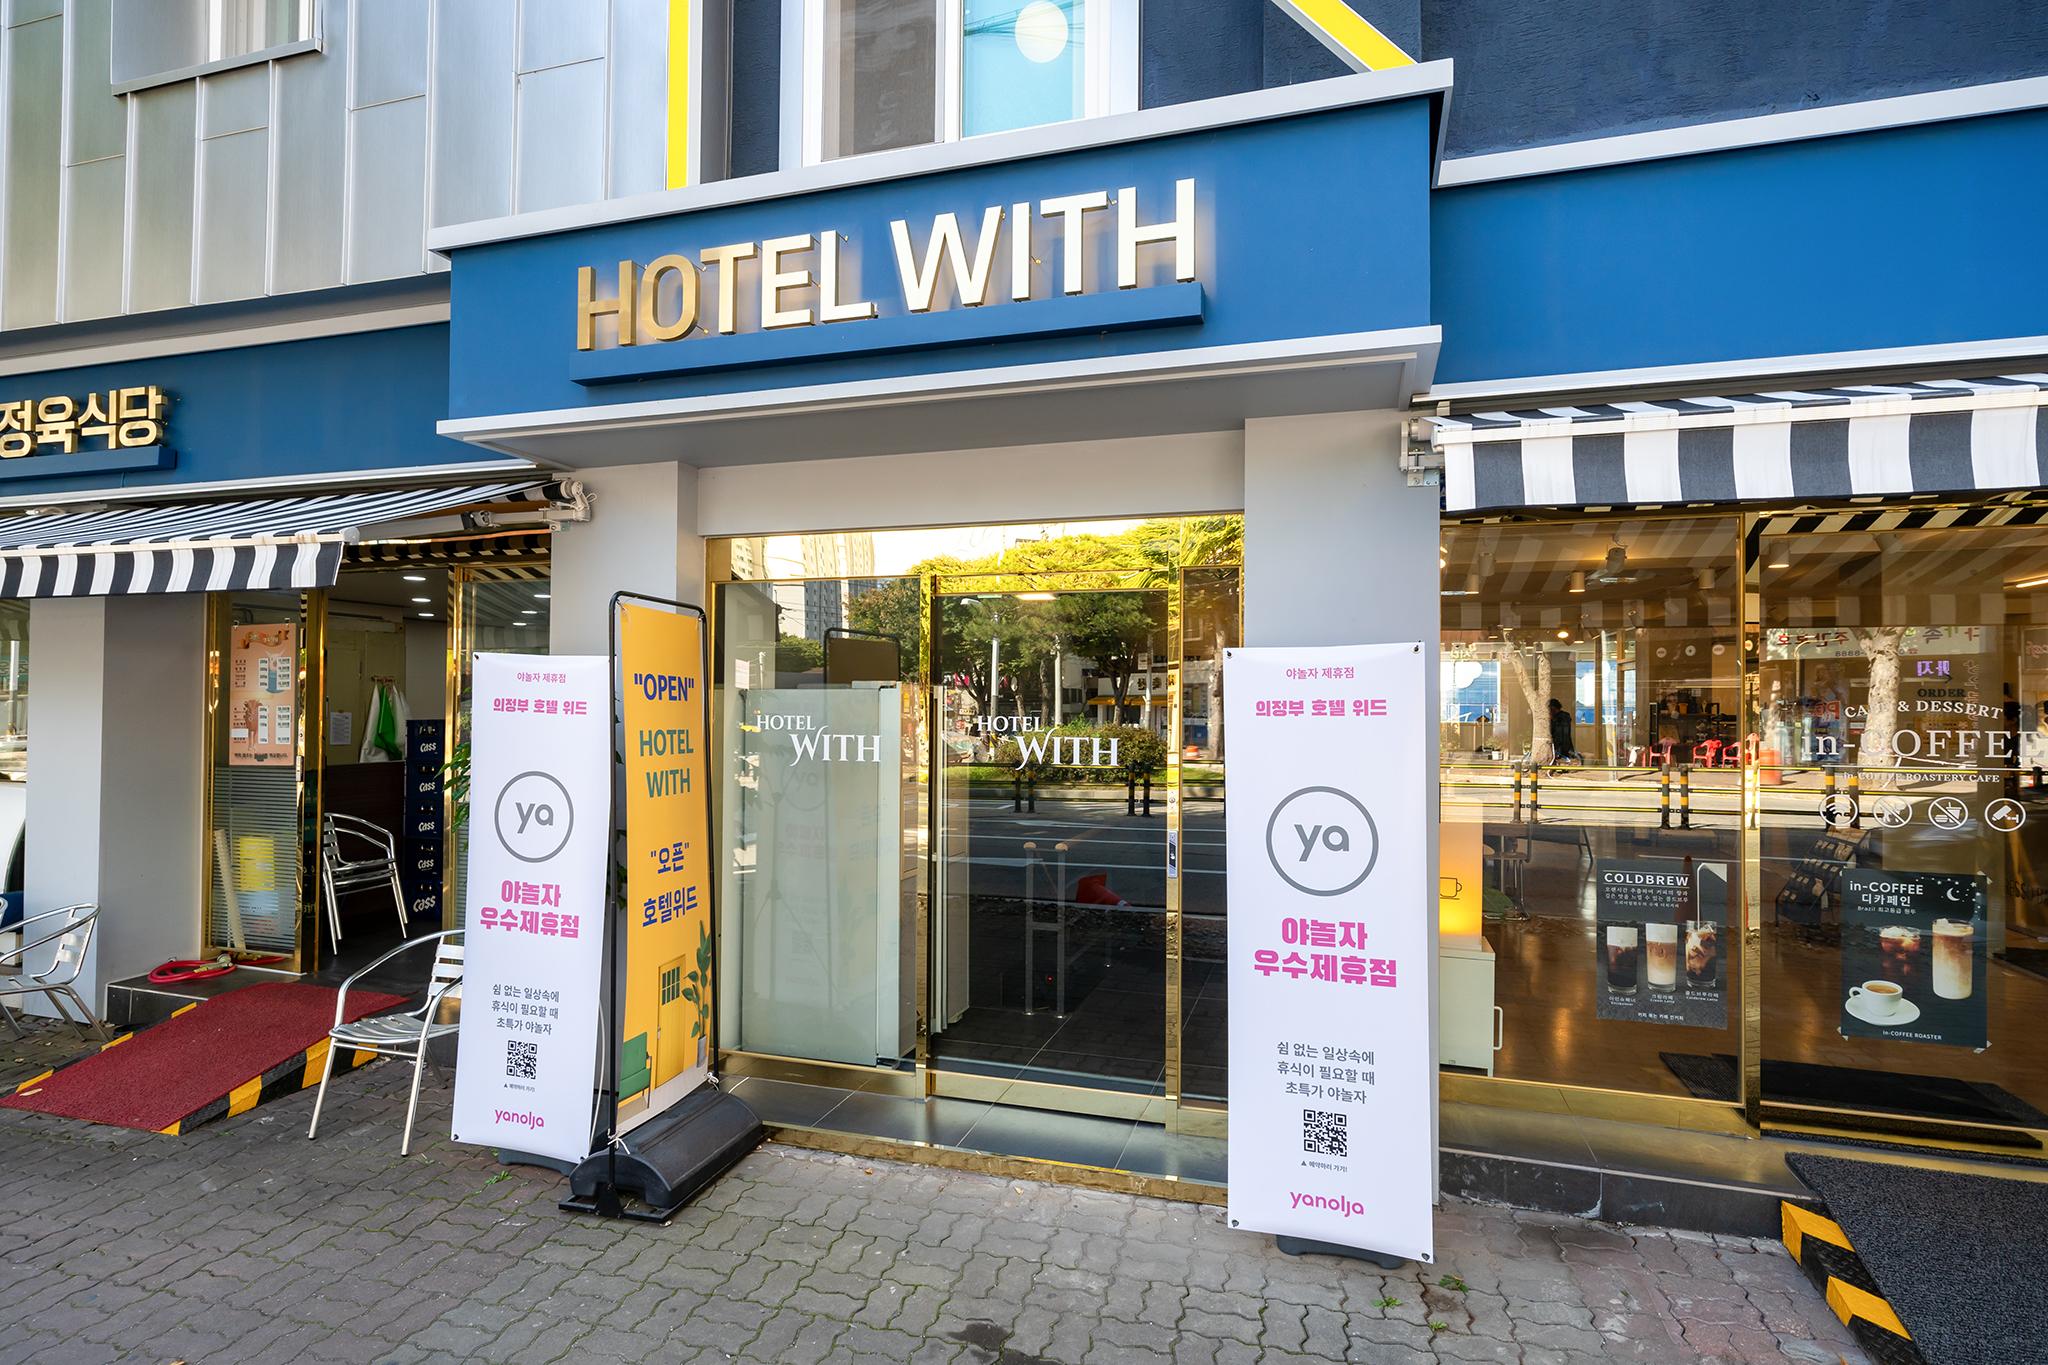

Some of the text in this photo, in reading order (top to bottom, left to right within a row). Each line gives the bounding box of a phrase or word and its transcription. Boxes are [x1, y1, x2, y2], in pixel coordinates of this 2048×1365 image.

[577, 178, 1196, 351] HOTEL WITH
[0, 385, 165, 459] 정육식당
[516, 672, 566, 684] 야놀자 제휴점
[1286, 667, 1355, 679] 야놀자 제휴점
[633, 672, 695, 701] "OPEN"
[1917, 688, 1966, 698] ORDER
[493, 698, 587, 715] 의정부 호텔 위드
[1255, 699, 1387, 717] 의정부 호텔 위드
[1897, 701, 1910, 713] &
[1915, 700, 2003, 720] DESSERT
[757, 714, 816, 731] HOTEL
[976, 715, 1045, 732] HOTEL
[640, 728, 694, 757] HOTEL
[789, 725, 881, 767] WITH
[1014, 727, 1120, 771] WITH
[1802, 729, 2044, 759] in-COFFEE
[646, 768, 691, 798] WITH
[1906, 774, 1970, 783] ROASTERY
[1970, 774, 2000, 784] CAFE
[515, 802, 554, 834] ya
[1294, 824, 1350, 862] ya
[650, 841, 690, 874] "오픈"
[1604, 873, 1688, 886] COLDBREW
[1849, 881, 1924, 895] in-COFFEE
[501, 880, 561, 907] 야놀자
[1861, 893, 1911, 907] 디카페인
[642, 885, 698, 928] 호텔위드
[480, 906, 579, 939] 우수제휴점
[1281, 917, 1368, 950] 야놀자
[1254, 949, 1397, 988] 우수제휴점
[492, 984, 560, 1003] 쉼 없는 일상속에
[492, 1000, 559, 1020] 휴식이 필요할 때
[496, 1017, 552, 1036] 초특가 야놀자
[1914, 1032, 1942, 1040] ROASTER
[1277, 1041, 1375, 1066] 쉼 없는 일상속에
[1277, 1061, 1375, 1086] 휴식이 필요할 때
[1285, 1082, 1367, 1104] 초특가 야놀자
[495, 1109, 545, 1130] yanolja
[1290, 1191, 1365, 1218] yanolja
